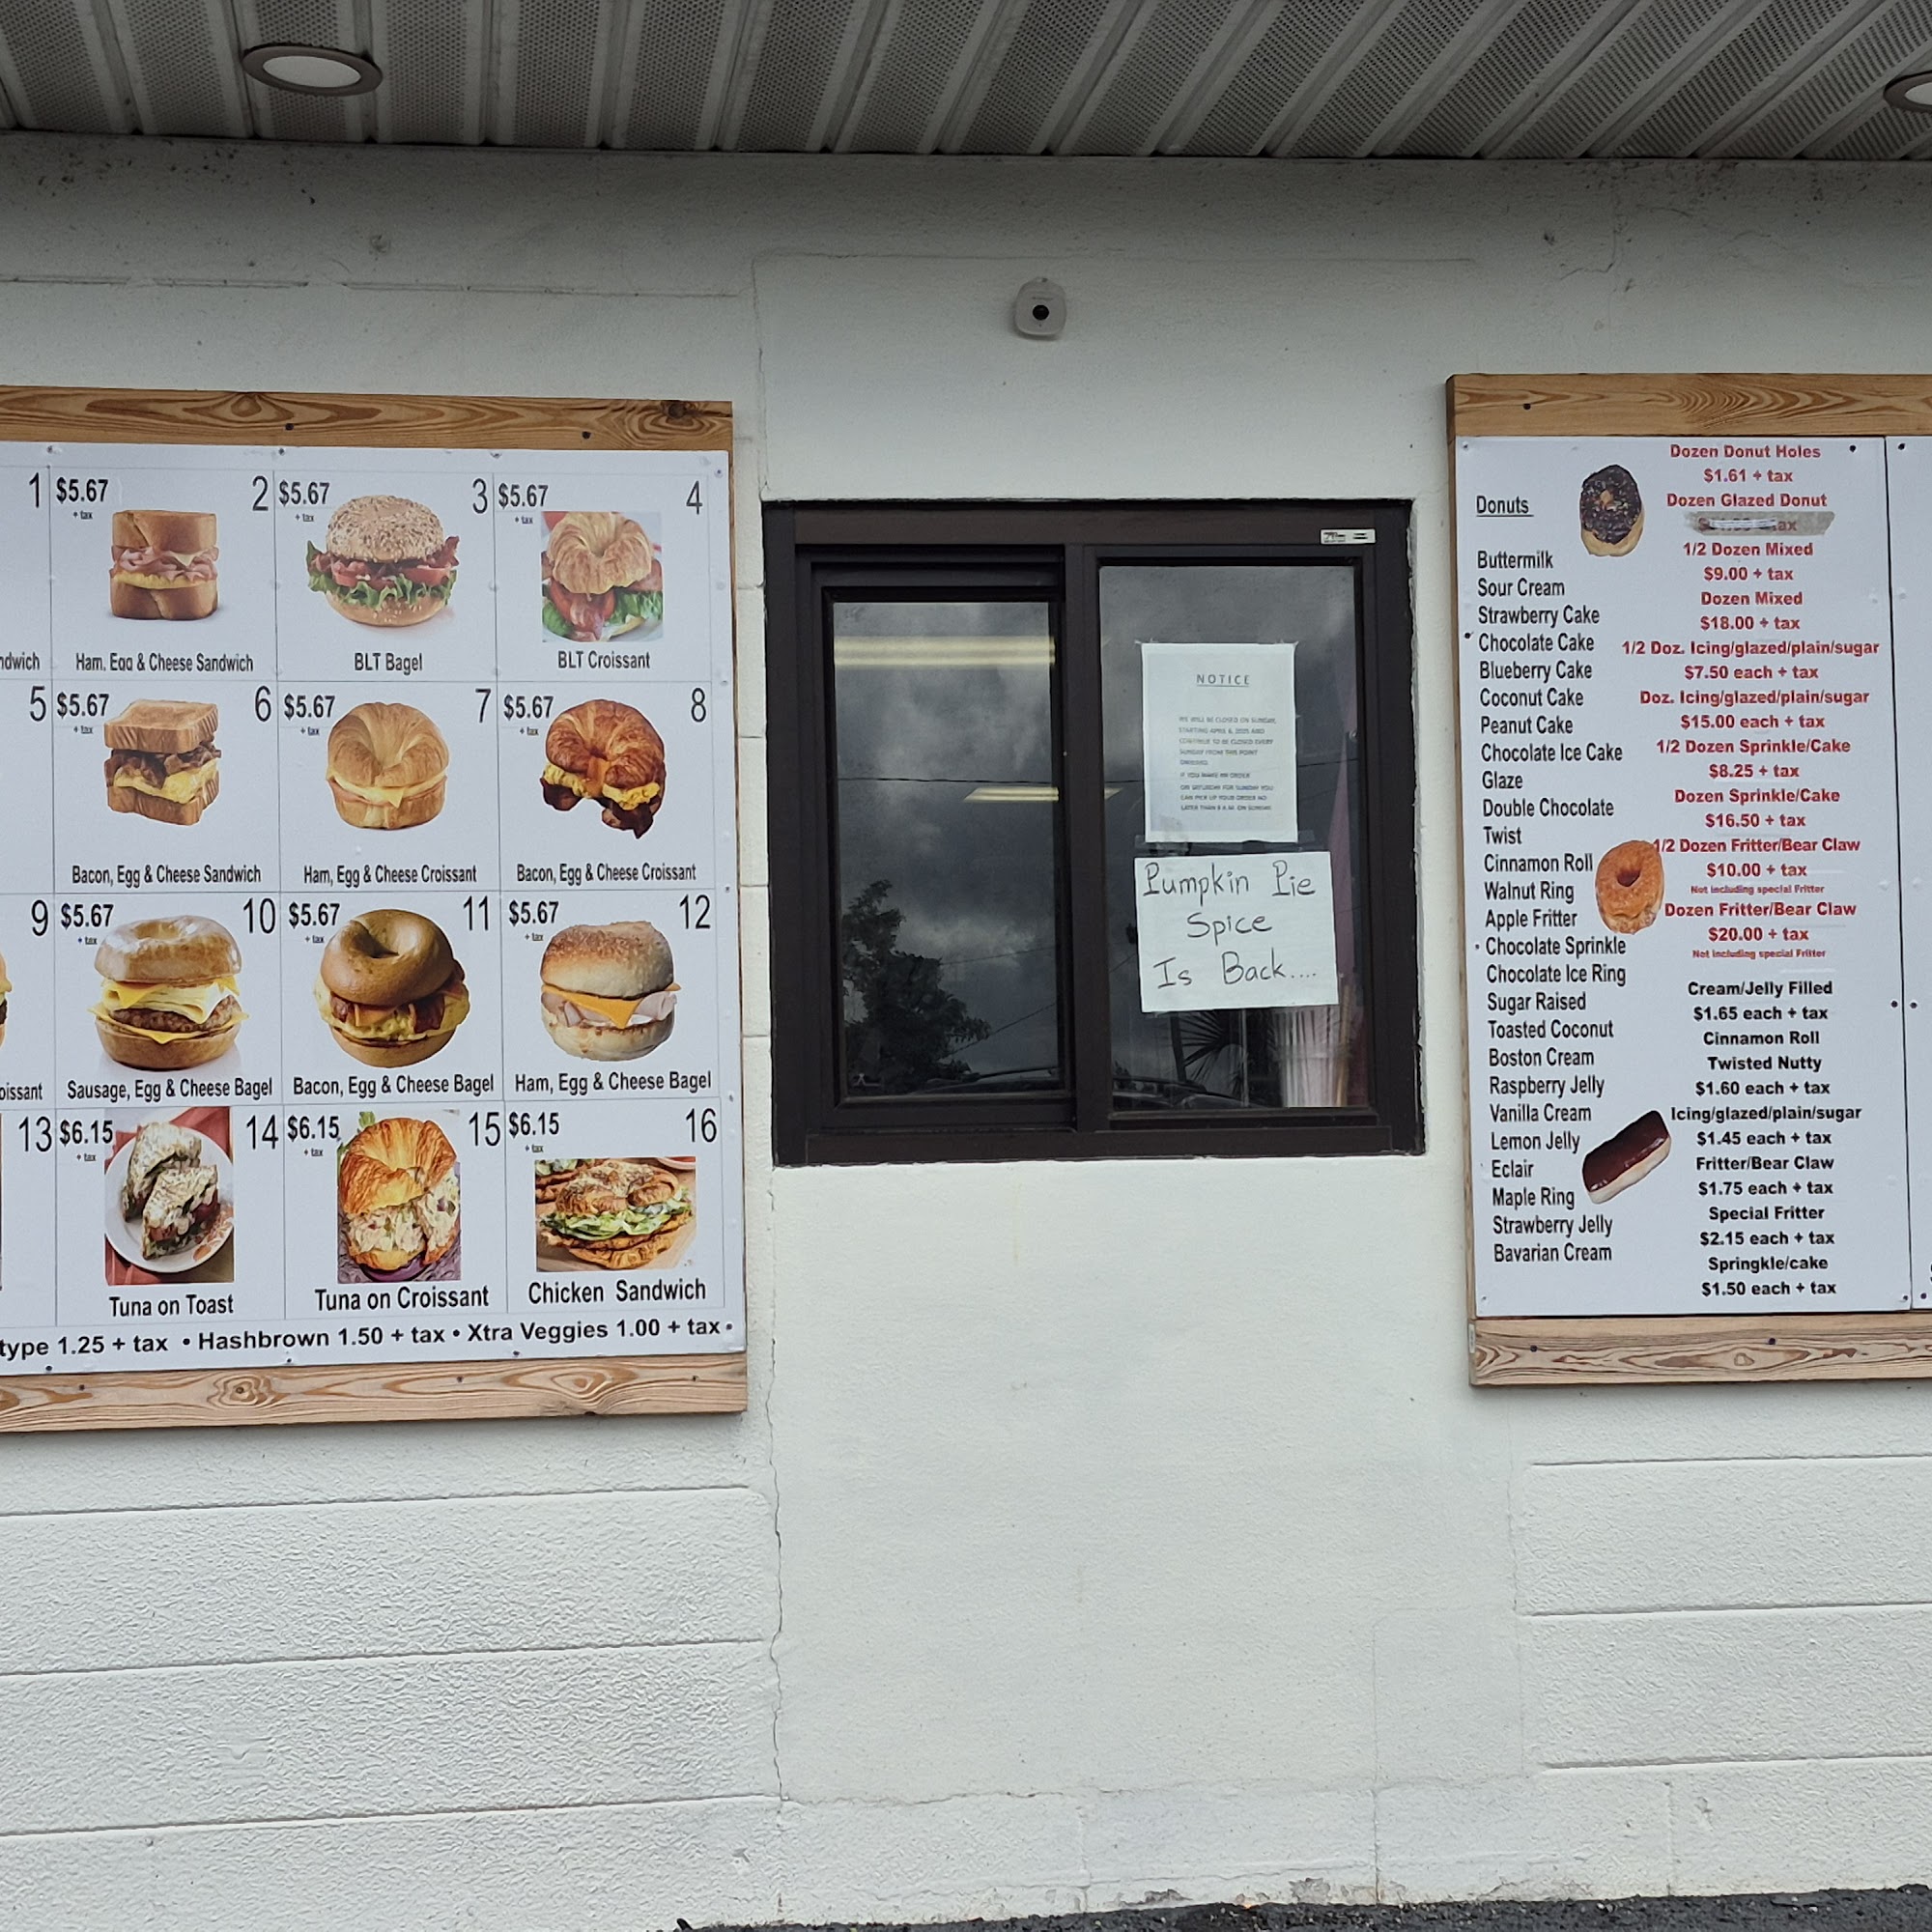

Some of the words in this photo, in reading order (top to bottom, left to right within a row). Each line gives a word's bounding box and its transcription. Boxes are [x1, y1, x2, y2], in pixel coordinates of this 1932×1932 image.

[1671, 444, 1718, 457] Dozen
[1723, 444, 1772, 458] Donut
[1776, 445, 1821, 458] Holes
[1704, 469, 1746, 483] $1.61
[1752, 469, 1762, 481] +
[1767, 469, 1793, 482] tax
[29, 472, 39, 508] 1
[56, 477, 108, 503] $5.67
[253, 476, 268, 511] 2
[279, 480, 329, 506] $5.67
[473, 478, 487, 514] 3
[498, 483, 548, 509] $5.67
[687, 481, 702, 515] 4
[1667, 494, 1715, 506] Dozen
[1721, 494, 1775, 506] Glazed
[1780, 494, 1827, 506] Donut
[1477, 496, 1528, 514] Donuts
[1478, 551, 1553, 568] Buttermilk
[1478, 578, 1513, 597] Sour
[1518, 578, 1564, 596] Cream
[1479, 606, 1558, 628] Strawberry
[1563, 605, 1600, 623] Cake
[355, 653, 381, 670] BLT
[385, 653, 422, 675] Bagel
[558, 651, 583, 668] BLT
[588, 651, 650, 668] Croissant
[1196, 673, 1250, 687] NOTICE
[1480, 661, 1550, 683] Blueberry
[1556, 661, 1592, 678] Cake
[30, 686, 46, 722] 5
[57, 692, 109, 719] $5.67
[255, 686, 271, 722] 6
[475, 689, 491, 723] 7
[504, 695, 554, 721] $5.67
[691, 688, 706, 722] 8
[1640, 691, 1674, 703] Doz.
[1681, 690, 1869, 707] Icing/glazed/plain/sugar
[1482, 717, 1532, 733] Peanut
[1537, 717, 1573, 733] Cake
[1681, 715, 1734, 729] $15.00
[1740, 715, 1778, 727] each
[1784, 715, 1794, 726] +
[1799, 715, 1825, 727] tax
[1482, 744, 1555, 761] Chocolate
[1561, 744, 1581, 761] Ice
[1586, 744, 1622, 760] Cake
[1483, 771, 1522, 788] Glaze
[1483, 826, 1521, 844] Twist
[1680, 838, 1726, 852] Dozen
[1732, 838, 1818, 852] Fritter/Bear
[1822, 838, 1861, 851] Claw
[72, 866, 113, 887] Bacon,
[118, 866, 140, 888] Egg
[144, 865, 153, 883] &
[156, 865, 200, 883] Cheese
[204, 865, 261, 882] Sandwich
[304, 866, 332, 886] Ham,
[337, 866, 359, 888] Egg
[363, 865, 371, 883] &
[376, 865, 417, 883] Cheese
[421, 865, 476, 882] Croissant
[1143, 862, 1248, 906] Pumpkin
[1272, 860, 1316, 896] Pie
[1485, 881, 1535, 899] Walnut
[1541, 881, 1574, 904] Ring
[1690, 885, 1709, 895] Not
[1710, 884, 1755, 896] including
[1756, 884, 1793, 895] special
[1794, 884, 1826, 894] Fritter
[32, 900, 48, 936] 9
[61, 903, 113, 930] $5.67
[243, 898, 275, 933] 10
[464, 895, 488, 930] 11
[509, 900, 558, 926] $5.67
[680, 895, 710, 929] 12
[1486, 909, 1528, 932] Apple
[1533, 909, 1577, 926] Fritter
[1187, 913, 1272, 946] Spice
[1709, 927, 1762, 942] $20.00
[1768, 928, 1777, 940] +
[1782, 927, 1808, 941] tax
[1487, 937, 1560, 954] Chocolate
[1566, 937, 1626, 959] Sprinkle
[1153, 957, 1192, 989] Is
[1689, 981, 1783, 998] Cream/Jelly
[1789, 980, 1833, 994] Filled
[1694, 1007, 1738, 1021] $1.65
[1744, 1007, 1781, 1019] each
[1787, 1007, 1798, 1019] +
[1803, 1007, 1828, 1019] tax
[1488, 1020, 1546, 1038] Toasted
[1551, 1020, 1613, 1037] Coconut
[1708, 1056, 1772, 1069] Twisted
[1778, 1056, 1821, 1072] Nutty
[68, 1080, 129, 1102] Sausage,
[135, 1080, 160, 1102] Egg
[166, 1079, 176, 1096] &
[181, 1079, 230, 1096] Cheese
[235, 1077, 271, 1100] Bagel
[516, 1074, 553, 1094] Ham,
[559, 1073, 587, 1095] Egg
[593, 1072, 604, 1090] &
[609, 1072, 664, 1090] Cheese
[669, 1071, 711, 1094] Bagel
[1490, 1076, 1566, 1098] Raspberry
[1571, 1076, 1605, 1097] Jelly
[19, 1117, 51, 1151] 13
[60, 1120, 113, 1147] $6.15
[246, 1115, 278, 1150] 14
[288, 1115, 339, 1142] $6.15
[469, 1112, 500, 1146] 15
[509, 1112, 558, 1138] $6.15
[686, 1108, 717, 1142] 16
[1492, 1132, 1541, 1151] Lemon
[1546, 1132, 1579, 1153] Jelly
[1492, 1160, 1534, 1178] Eclair
[1492, 1188, 1535, 1210] Maple
[1541, 1188, 1574, 1210] Ring
[1709, 1207, 1769, 1223] Special
[1775, 1206, 1825, 1219] Fritter
[1494, 1244, 1558, 1262] Bavarian
[1564, 1244, 1611, 1261] Cream
[1709, 1256, 1828, 1273] Springkle/cake
[315, 1290, 360, 1311] Tuna
[368, 1293, 390, 1310] on
[398, 1286, 489, 1308] Croissant
[529, 1281, 603, 1304] Chicken
[616, 1278, 705, 1301] Sandwich
[109, 1296, 152, 1317] Tuna
[158, 1300, 179, 1316] on
[185, 1294, 233, 1315] Toast
[58, 1336, 104, 1354] 1.25
[113, 1338, 126, 1350] +
[133, 1336, 168, 1351] tax
[199, 1331, 328, 1350] Hashbrown
[339, 1327, 383, 1345] 1.50
[390, 1328, 405, 1342] +
[412, 1327, 444, 1343] tax
[468, 1324, 512, 1341] Xtra
[521, 1321, 608, 1344] Veggies
[617, 1319, 660, 1337] 1.00
[668, 1321, 680, 1333] +
[688, 1319, 720, 1335] tax
